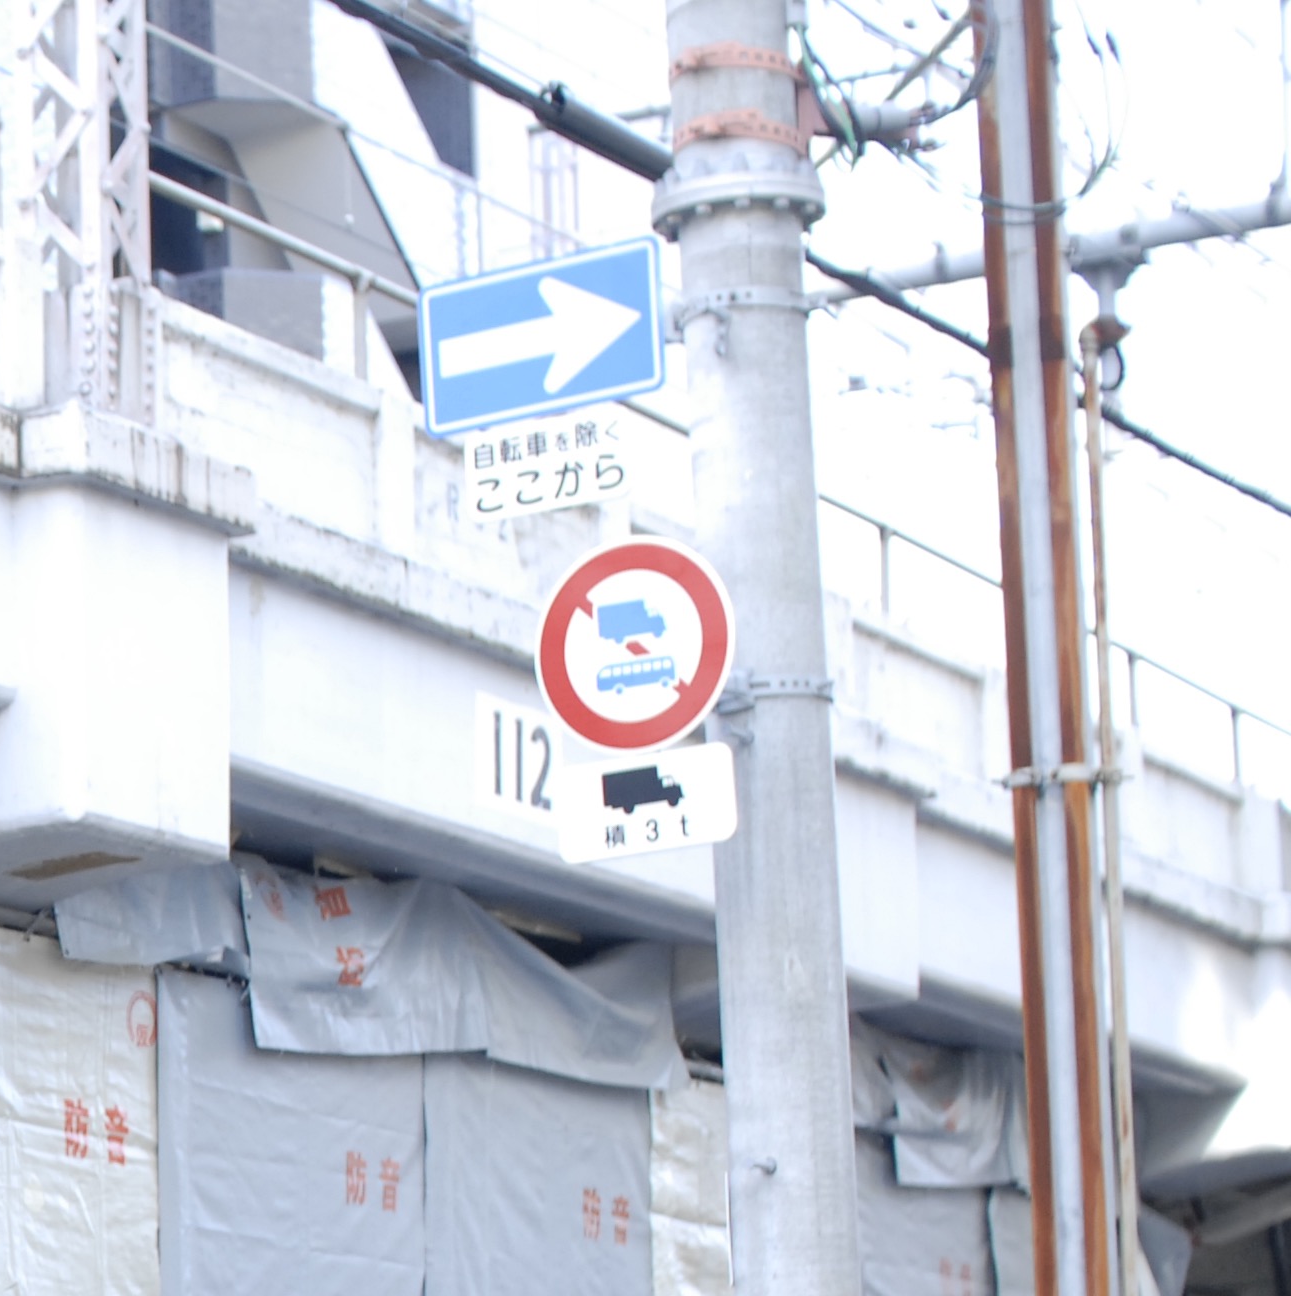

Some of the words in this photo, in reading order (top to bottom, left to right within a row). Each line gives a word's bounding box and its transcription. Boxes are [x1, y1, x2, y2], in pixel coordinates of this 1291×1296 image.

[474, 420, 620, 470] 自転車を除く
[476, 454, 624, 514] ここから
[493, 711, 552, 811] 112
[64, 1098, 129, 1167] 防音
[346, 1150, 400, 1212] 防音
